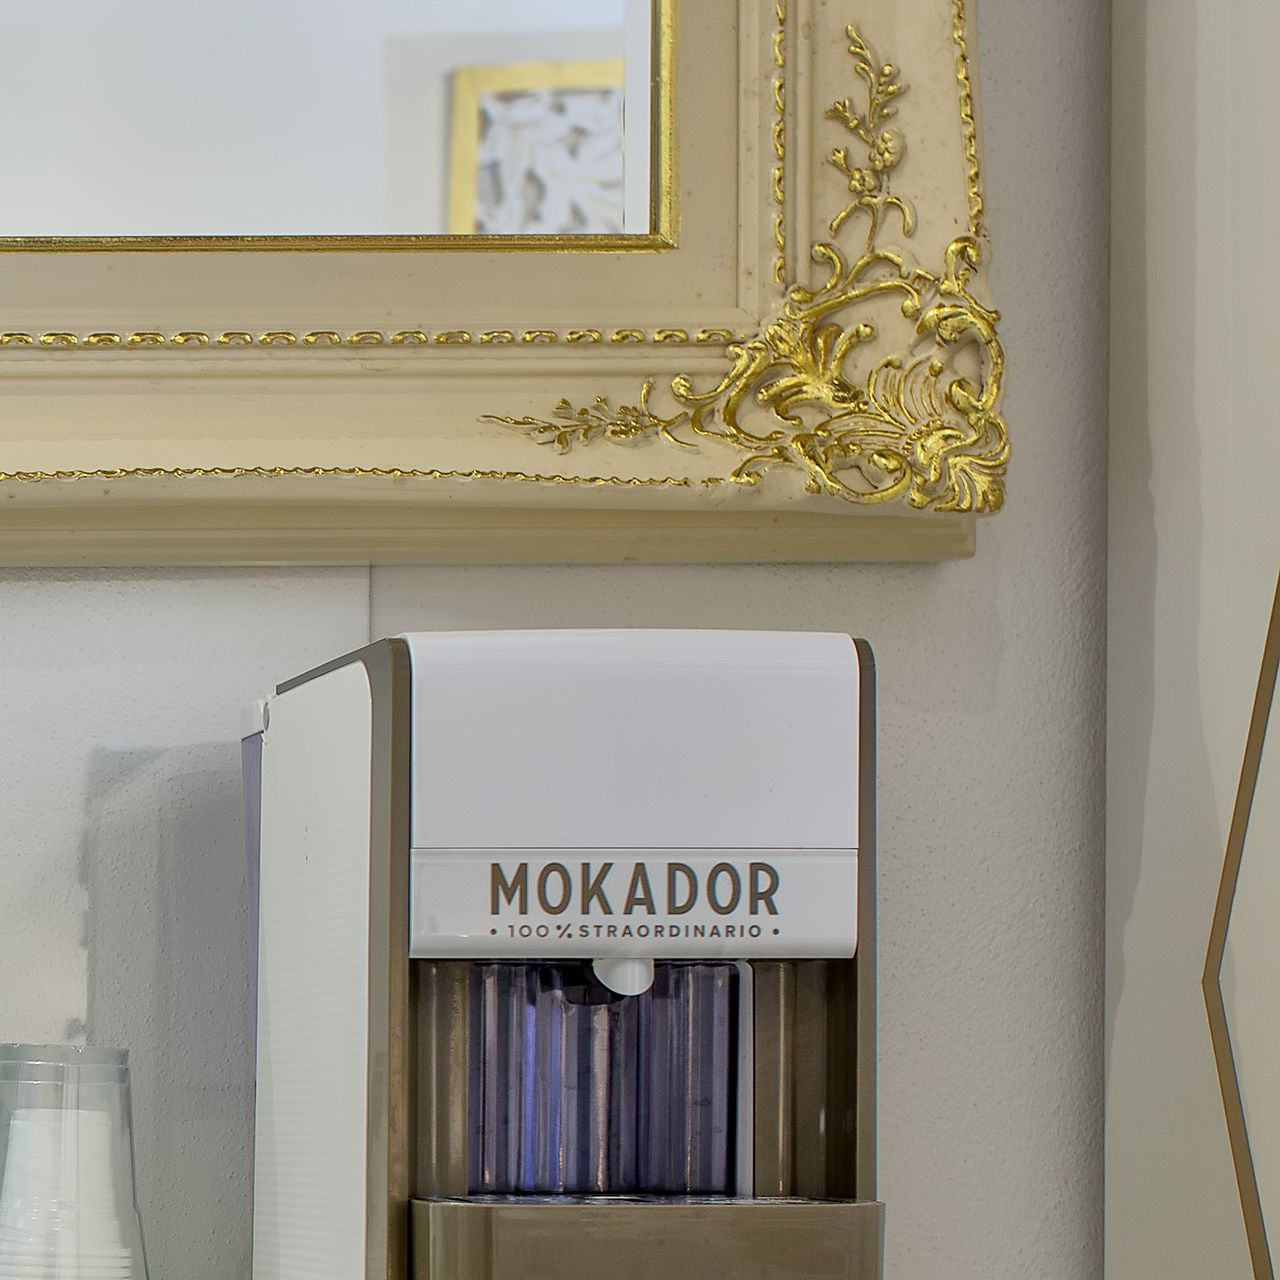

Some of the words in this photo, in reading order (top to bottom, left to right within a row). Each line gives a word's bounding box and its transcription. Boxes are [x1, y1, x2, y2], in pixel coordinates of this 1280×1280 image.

[490, 861, 781, 916] MOKADOR
[507, 923, 573, 939] 100%
[578, 924, 762, 939] STRAORDINARIO
